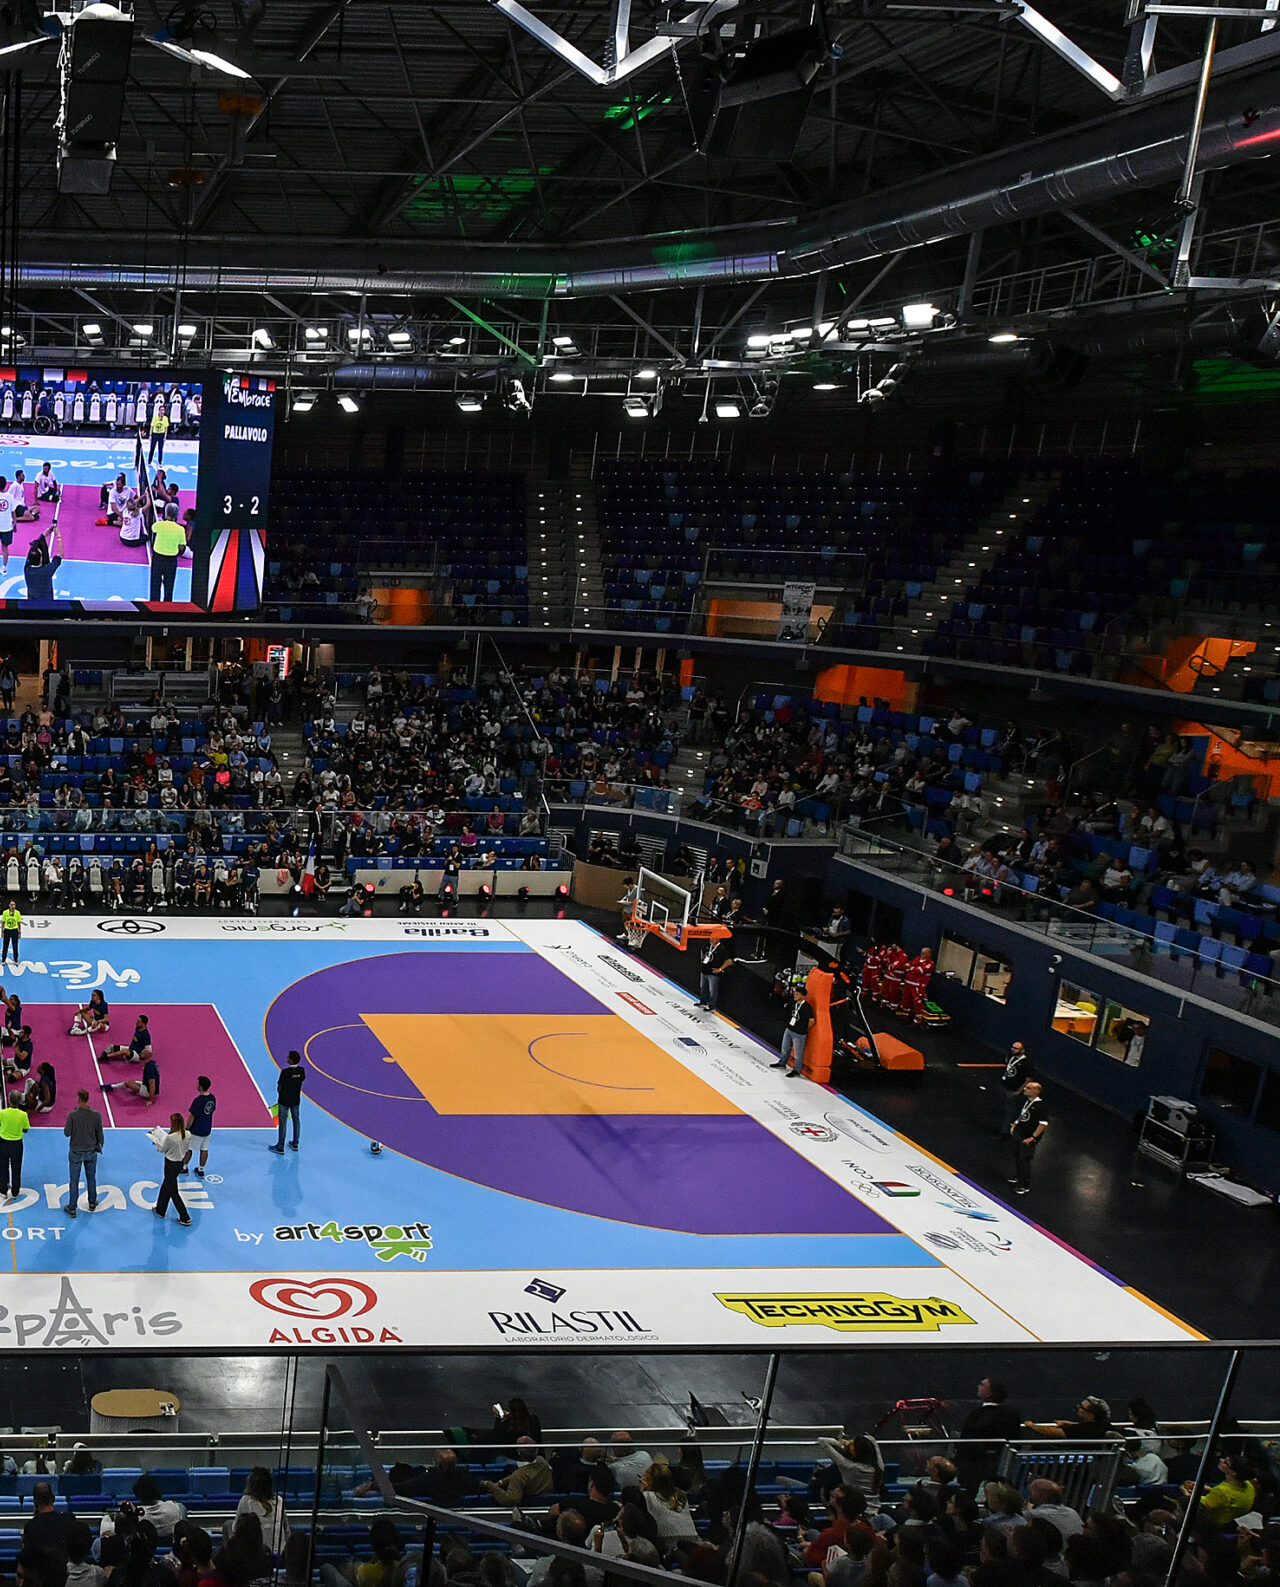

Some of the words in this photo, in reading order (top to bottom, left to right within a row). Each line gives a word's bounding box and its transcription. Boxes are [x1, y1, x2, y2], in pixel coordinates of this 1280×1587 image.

[224, 425, 268, 442] PALLAVOLO
[223, 495, 232, 514] 3
[250, 496, 260, 515] 2
[404, 928, 490, 937] Barilla
[841, 1159, 874, 1180] CONI
[234, 1228, 264, 1246] by
[274, 1221, 432, 1243] art4sport
[726, 1298, 960, 1325] TECHNOGYM
[488, 1310, 652, 1335] RILASTIL
[269, 1327, 404, 1344] ALGIDA
[504, 1335, 574, 1343] LABORATORIO
[576, 1334, 659, 1342] DERMATOLOGICO
